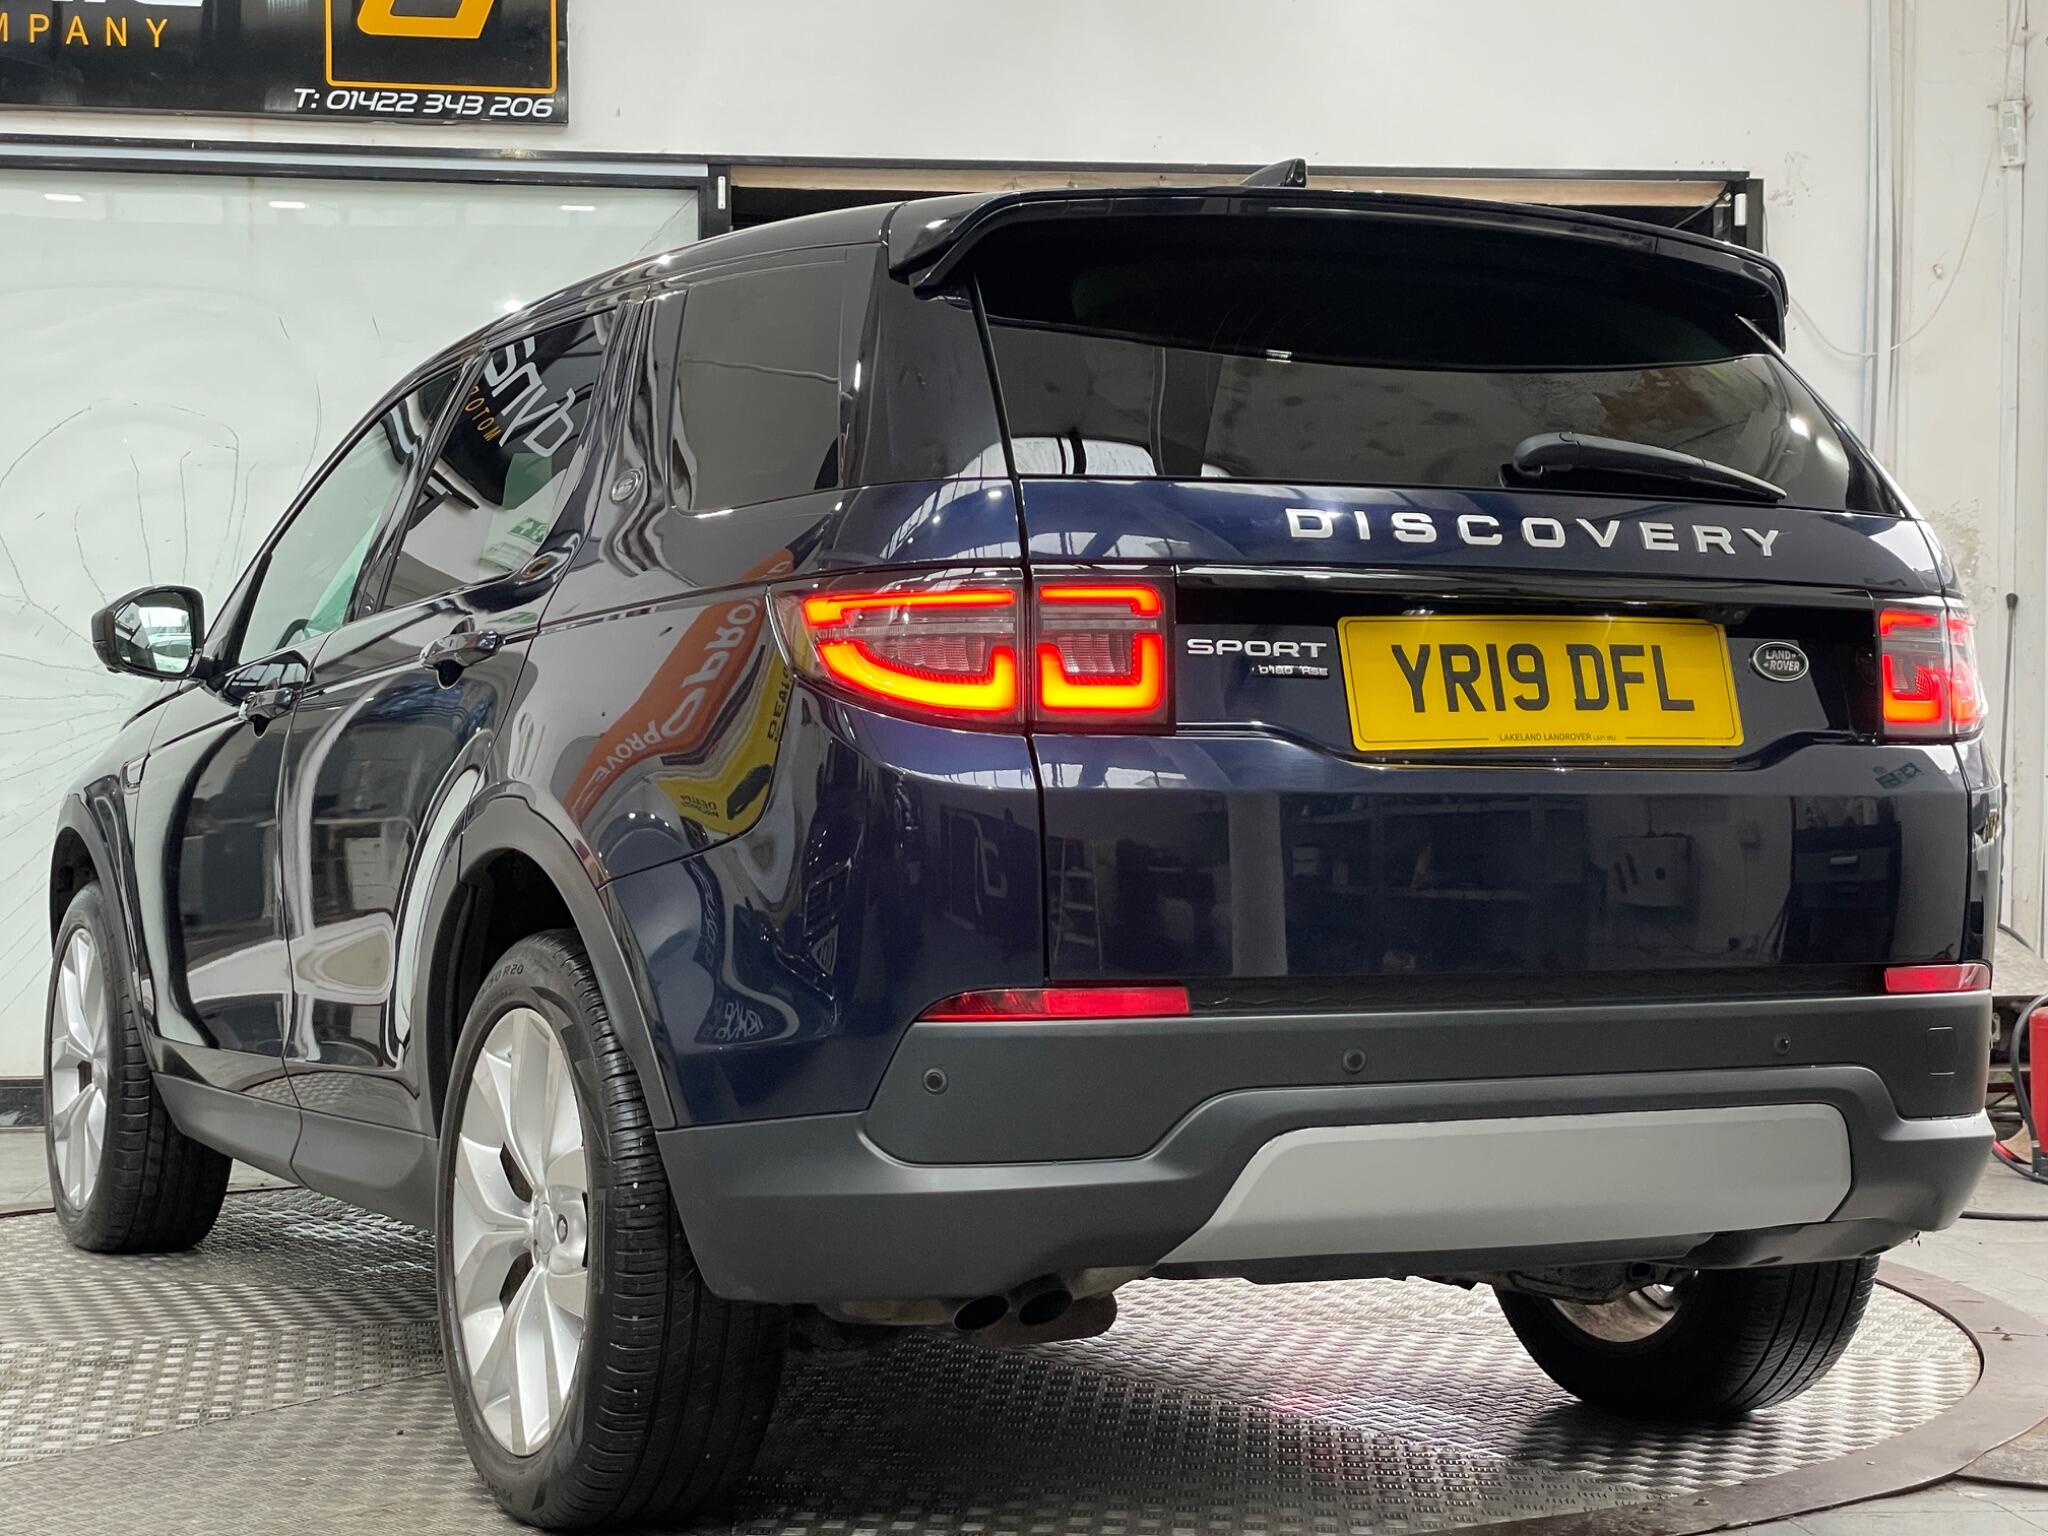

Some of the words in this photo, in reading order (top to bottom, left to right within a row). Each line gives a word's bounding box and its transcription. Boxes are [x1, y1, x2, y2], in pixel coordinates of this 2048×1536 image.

[294, 89, 320, 109] T:
[326, 90, 418, 113] 01422
[423, 94, 483, 116] 343
[489, 97, 555, 118] 206
[1285, 508, 1779, 557] DISCOVERY
[1186, 638, 1327, 658] SPORT
[1765, 650, 1791, 660] LAND
[1770, 660, 1800, 671] ROVER
[1391, 643, 1550, 713] YR19
[1565, 643, 1695, 712] DFL
[1499, 733, 1542, 741] LAKELAND
[1543, 732, 1592, 741] LANDROVER
[503, 963, 524, 977] R20
